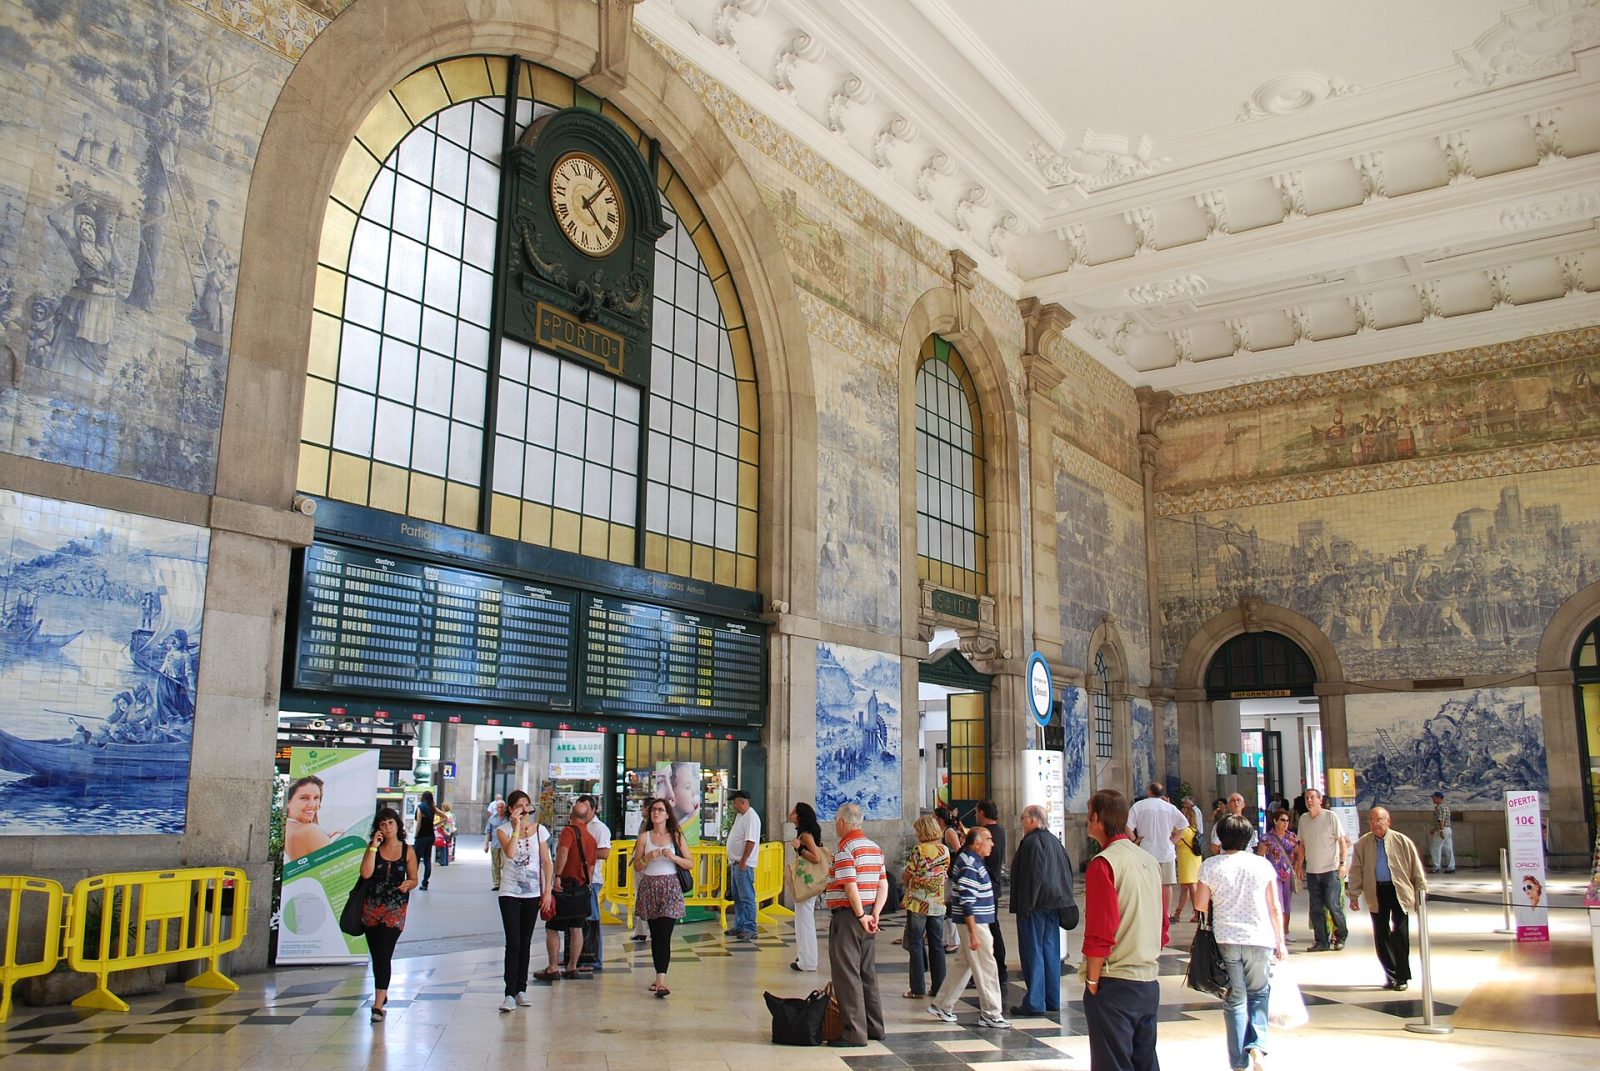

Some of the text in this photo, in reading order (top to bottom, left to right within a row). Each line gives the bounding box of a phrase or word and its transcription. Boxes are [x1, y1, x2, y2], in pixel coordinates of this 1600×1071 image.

[551, 315, 611, 359] PORTO
[1508, 795, 1537, 808] OFERTA
[1514, 815, 1535, 825] 10€
